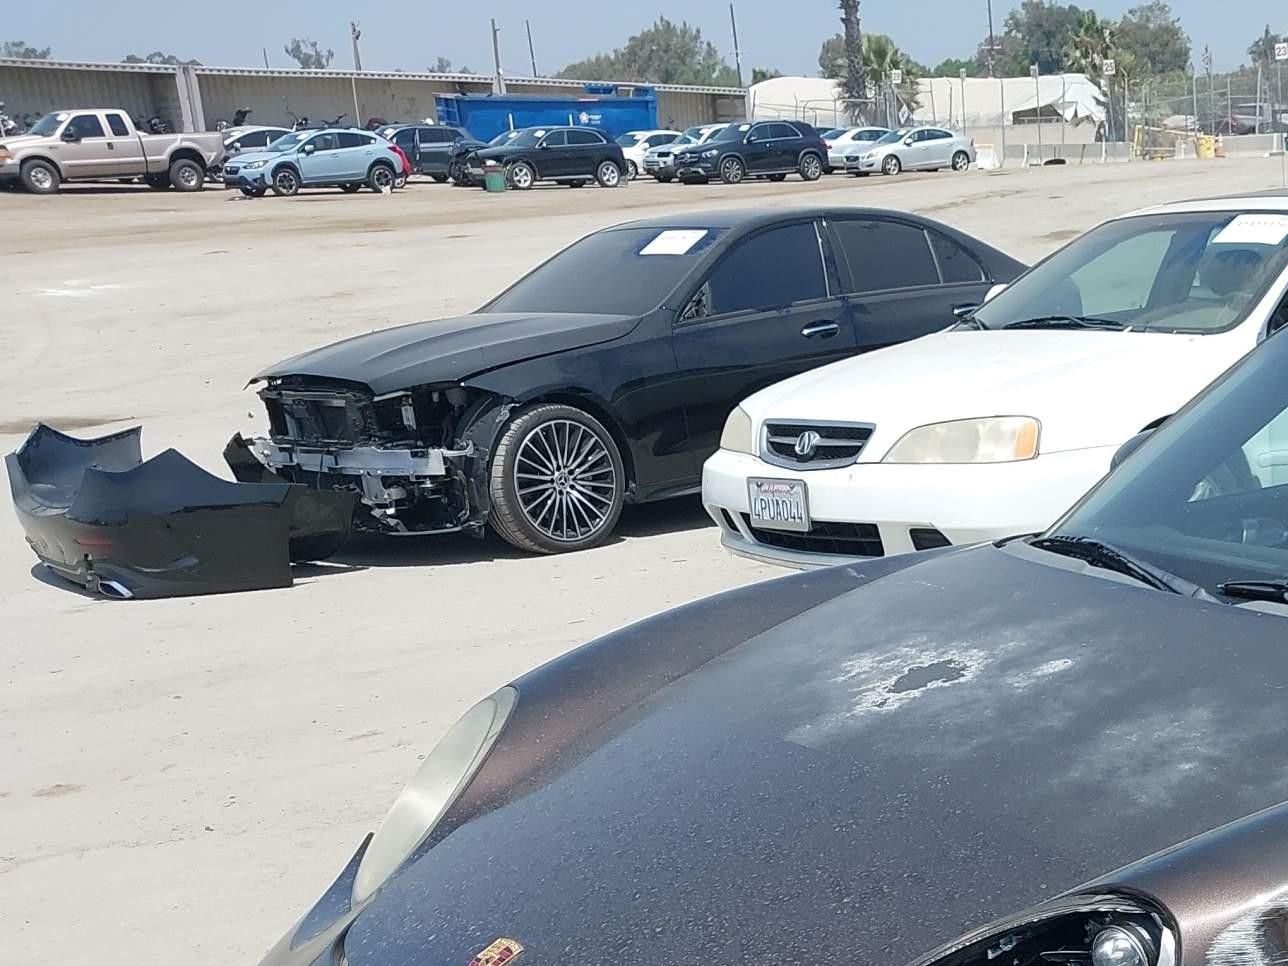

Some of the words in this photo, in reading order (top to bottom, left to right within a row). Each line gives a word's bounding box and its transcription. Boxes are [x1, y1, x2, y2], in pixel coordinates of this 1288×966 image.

[1276, 46, 1287, 57] 23
[1104, 60, 1114, 73] 25
[754, 497, 804, 523] 4PUA044
